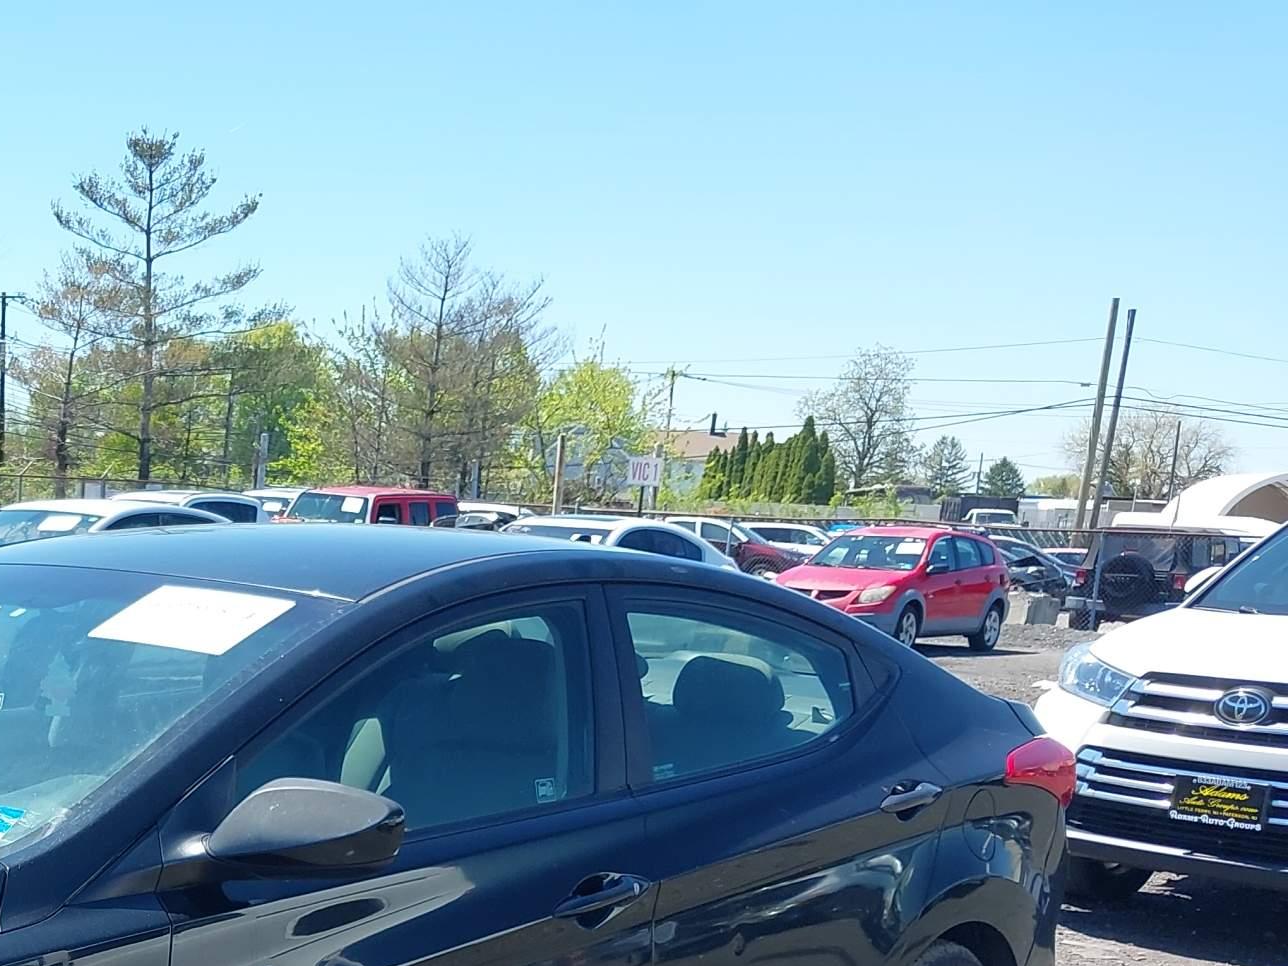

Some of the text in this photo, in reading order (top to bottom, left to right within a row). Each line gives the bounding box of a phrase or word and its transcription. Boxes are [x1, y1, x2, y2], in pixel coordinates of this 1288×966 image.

[632, 462, 658, 481] VIC 1
[1191, 785, 1249, 801] Adams
